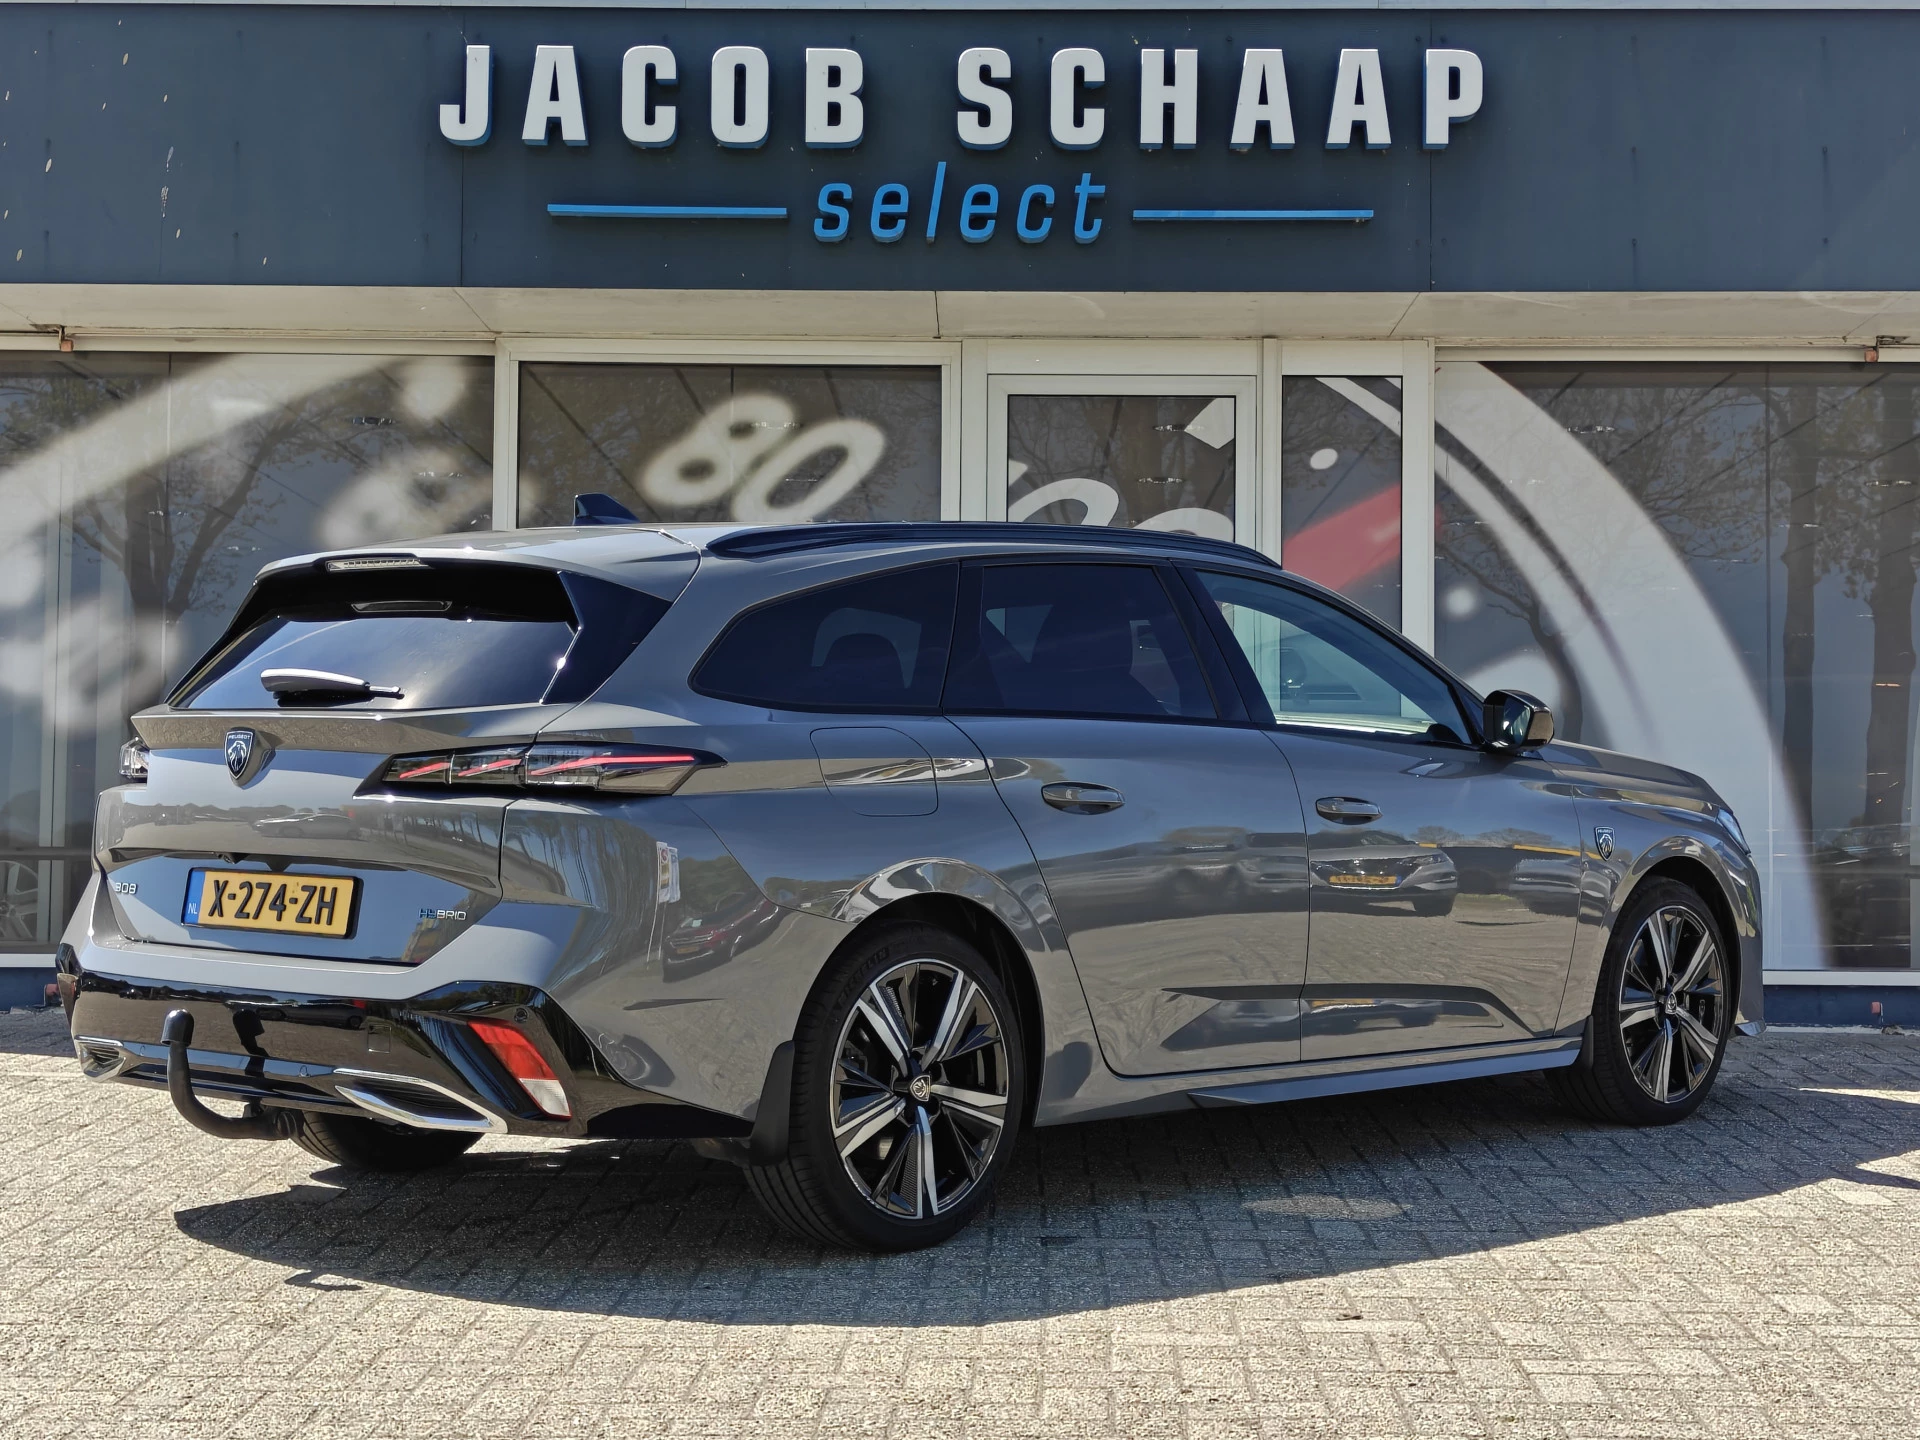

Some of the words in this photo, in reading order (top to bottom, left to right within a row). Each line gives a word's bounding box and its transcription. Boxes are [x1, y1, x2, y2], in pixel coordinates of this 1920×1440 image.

[438, 45, 866, 149] JACOB
[956, 47, 1484, 149] SCHAAP
[814, 161, 1106, 244] select
[115, 882, 137, 894] 308
[208, 879, 338, 926] X-274-ZH
[187, 902, 198, 915] NL
[419, 908, 467, 921] HYBRID
